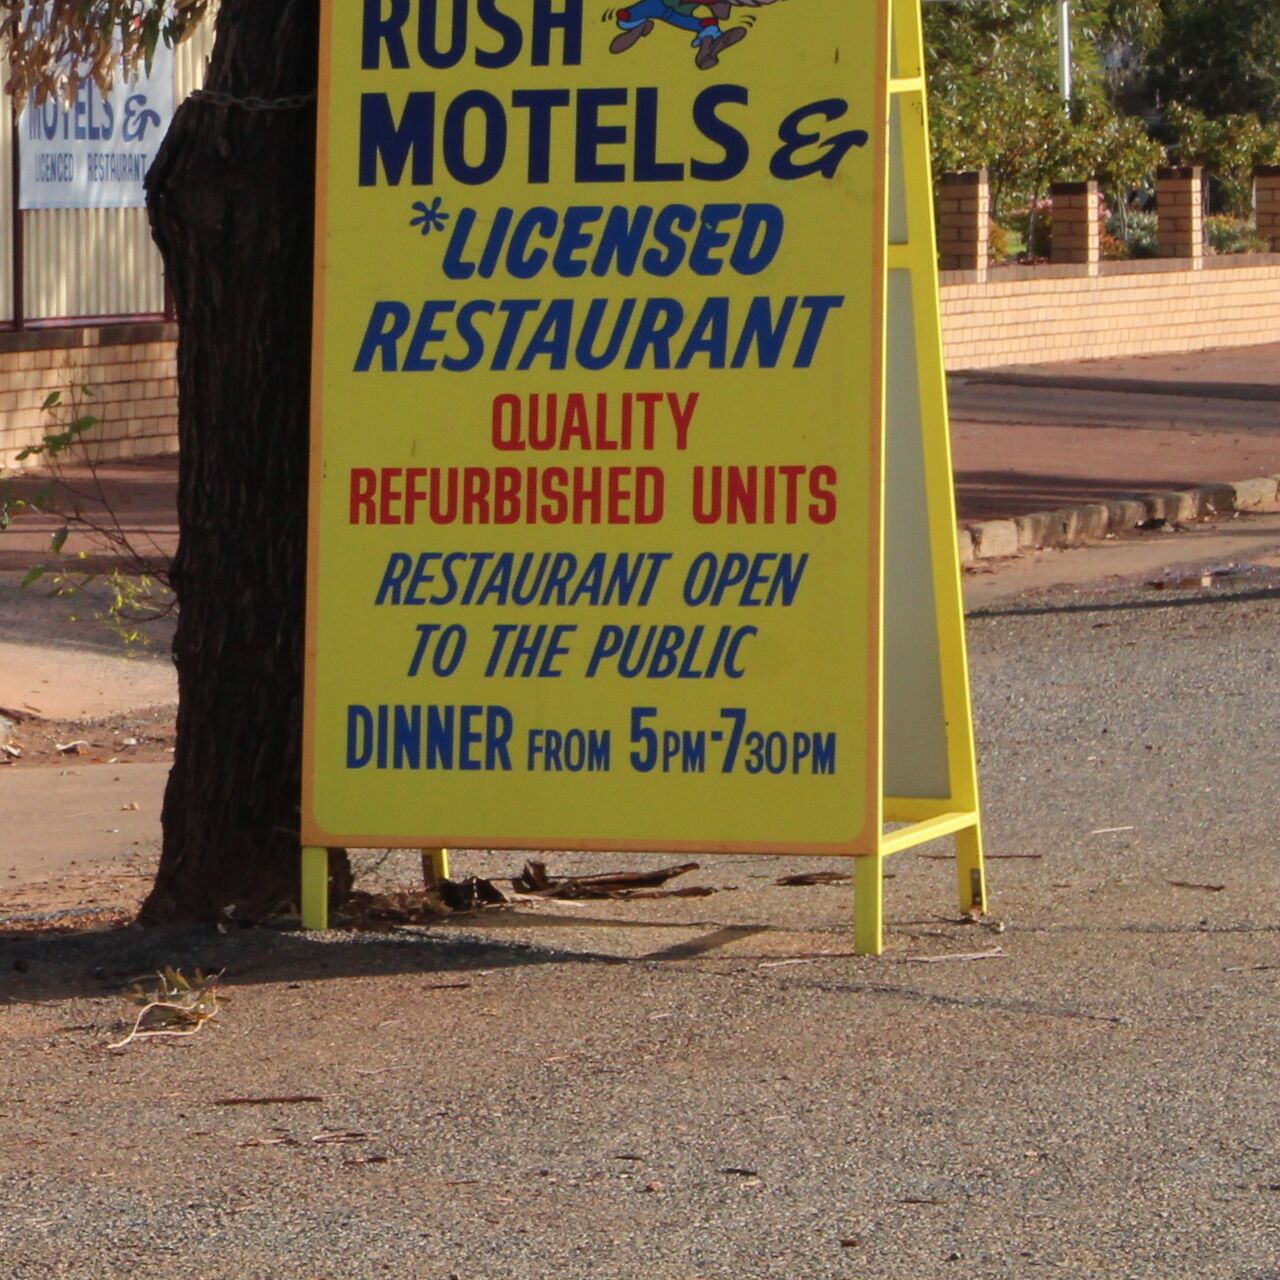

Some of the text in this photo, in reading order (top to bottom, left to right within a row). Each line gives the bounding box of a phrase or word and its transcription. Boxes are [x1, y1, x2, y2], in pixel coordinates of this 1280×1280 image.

[121, 93, 161, 142] &
[358, 84, 868, 187] MOTELS &
[353, 296, 845, 372] RESTAURANT
[492, 392, 699, 452] QUALITY
[349, 465, 838, 525] REFURBISHED UNITS
[375, 552, 809, 606] RESTAURANT OPEN
[407, 624, 758, 679] TO THE PUBLIC
[346, 705, 513, 771] DINNER
[527, 729, 611, 772] FROM
